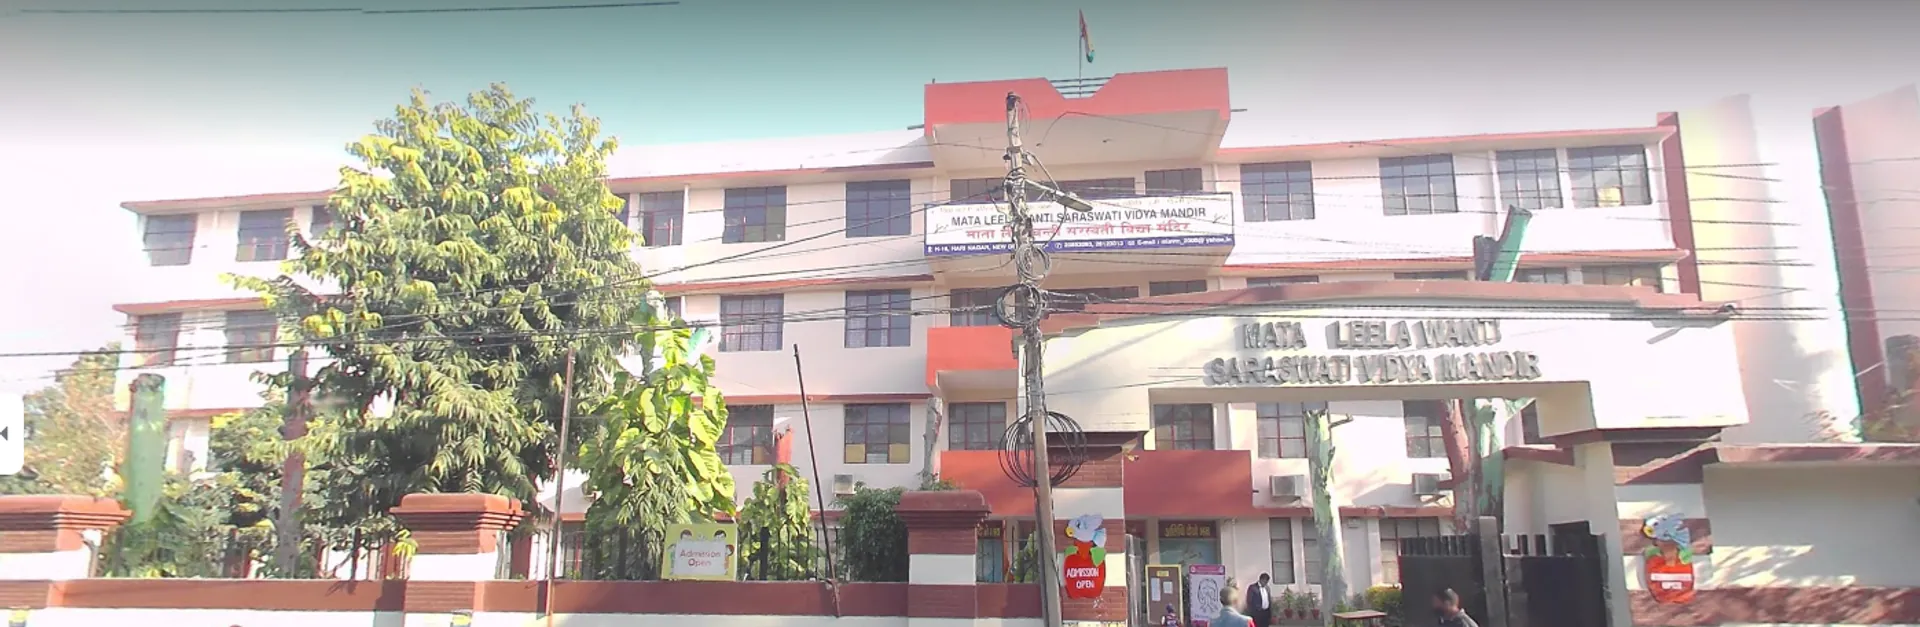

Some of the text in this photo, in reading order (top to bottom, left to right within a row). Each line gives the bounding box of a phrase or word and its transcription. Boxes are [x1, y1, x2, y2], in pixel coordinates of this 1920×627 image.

[951, 215, 981, 227] MATA
[1057, 210, 1122, 223] SARASWATI
[1124, 208, 1157, 220] VIDYA
[1160, 207, 1207, 219] MANDIR
[966, 229, 996, 239] माता
[1236, 319, 1502, 350] MATA LEELA WANTI
[1203, 350, 1542, 386] SARASWATI VIDYA MANDIR
[688, 558, 712, 567] Open
[1066, 567, 1099, 578] ADMISSION
[1076, 580, 1096, 589] OPEN
